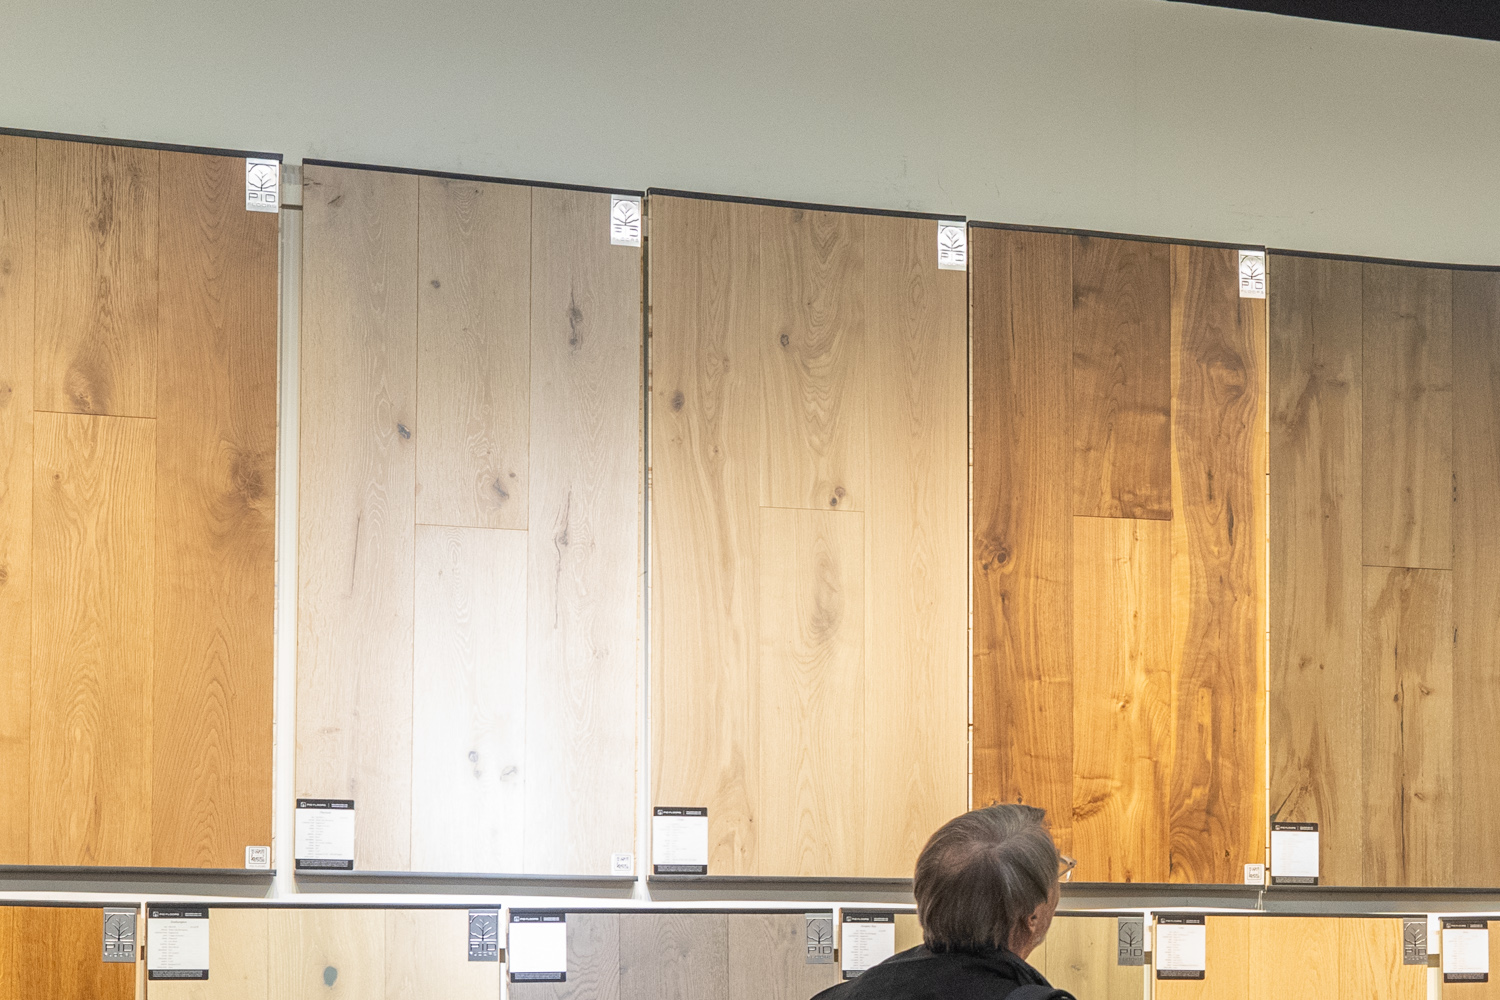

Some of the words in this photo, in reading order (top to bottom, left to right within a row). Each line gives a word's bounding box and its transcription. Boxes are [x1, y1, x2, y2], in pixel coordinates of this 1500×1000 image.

[248, 192, 276, 202] PID
[1241, 280, 1264, 290] PID
[105, 942, 134, 952] PID
[470, 942, 496, 951] PID
[808, 946, 832, 954] PID
[1120, 948, 1142, 957] PID
[1404, 947, 1426, 956] PID
